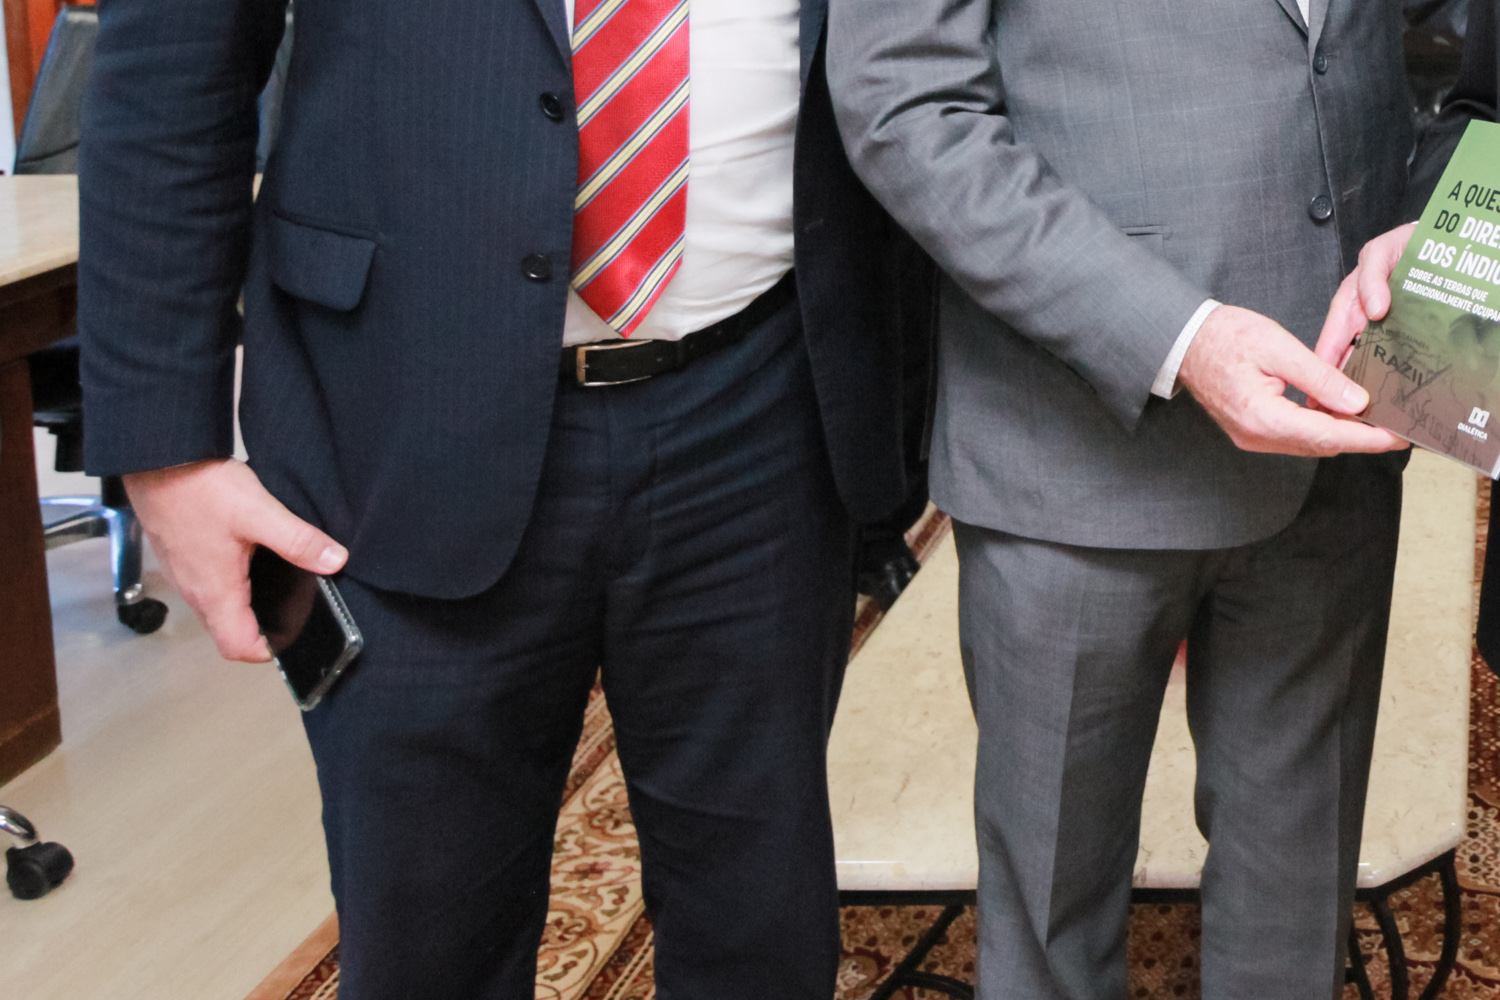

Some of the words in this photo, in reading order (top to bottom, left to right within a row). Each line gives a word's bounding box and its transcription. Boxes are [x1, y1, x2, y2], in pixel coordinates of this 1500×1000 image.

[1448, 181, 1462, 201] A
[1433, 209, 1460, 233] DO
[1417, 238, 1457, 268] DOS
[1402, 279, 1474, 312] TRADICIONALMENTE
[1408, 267, 1434, 283] SOBRE
[1431, 275, 1444, 286] AS
[1443, 278, 1472, 297] TERRAS
[1471, 288, 1489, 302] QUE
[1457, 422, 1488, 440] DIALÉTICA
